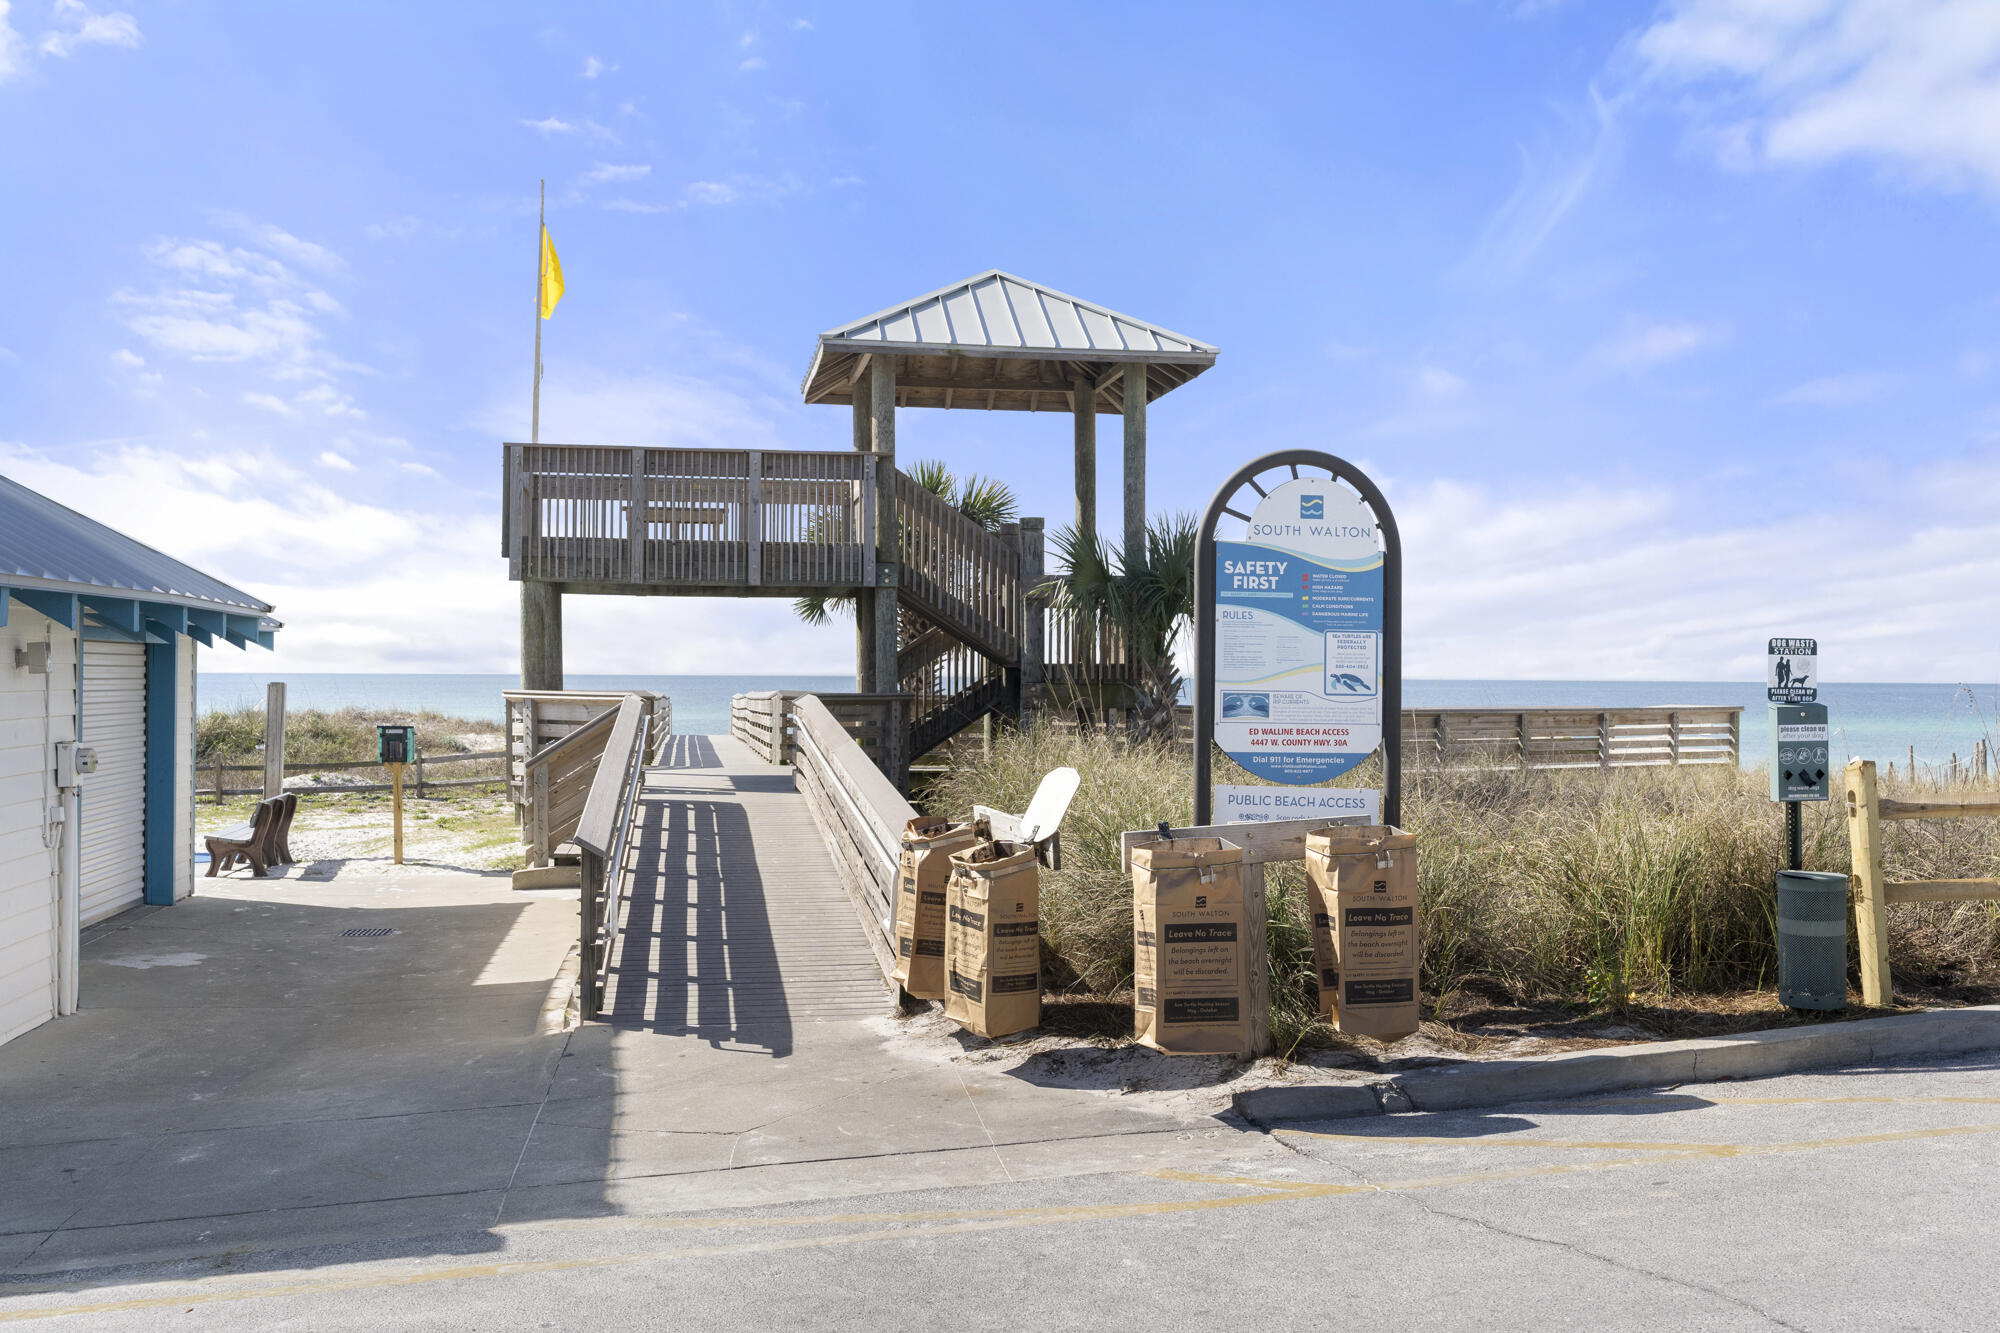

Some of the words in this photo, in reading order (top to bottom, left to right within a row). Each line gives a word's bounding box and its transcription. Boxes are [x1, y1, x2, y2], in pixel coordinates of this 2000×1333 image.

[1253, 524, 1301, 536] SOUTH
[1309, 526, 1371, 538] WALTON
[1223, 560, 1288, 575] SAFETY
[1233, 575, 1279, 590] FIRST
[1222, 610, 1254, 620] RULES
[1772, 639, 1786, 647] DOG
[1788, 640, 1814, 648] WASTE
[1261, 728, 1294, 736] WALLINE
[1296, 756, 1344, 764] Emergencies
[1228, 794, 1272, 806] PUBLIC
[1274, 796, 1316, 808] BEACH
[1318, 797, 1366, 809] ACCESS
[1348, 913, 1372, 922] Leave
[1374, 913, 1386, 921] No
[1389, 913, 1409, 921] Trace
[1168, 929, 1192, 938] Leave
[1195, 929, 1206, 937] No
[1209, 928, 1232, 937] Trace
[1351, 930, 1386, 938] Belongings
[1387, 930, 1397, 938] left
[1380, 940, 1408, 948] overnight
[1171, 947, 1206, 955] Belongings
[1207, 946, 1218, 954] left
[1200, 956, 1232, 965] overnight
